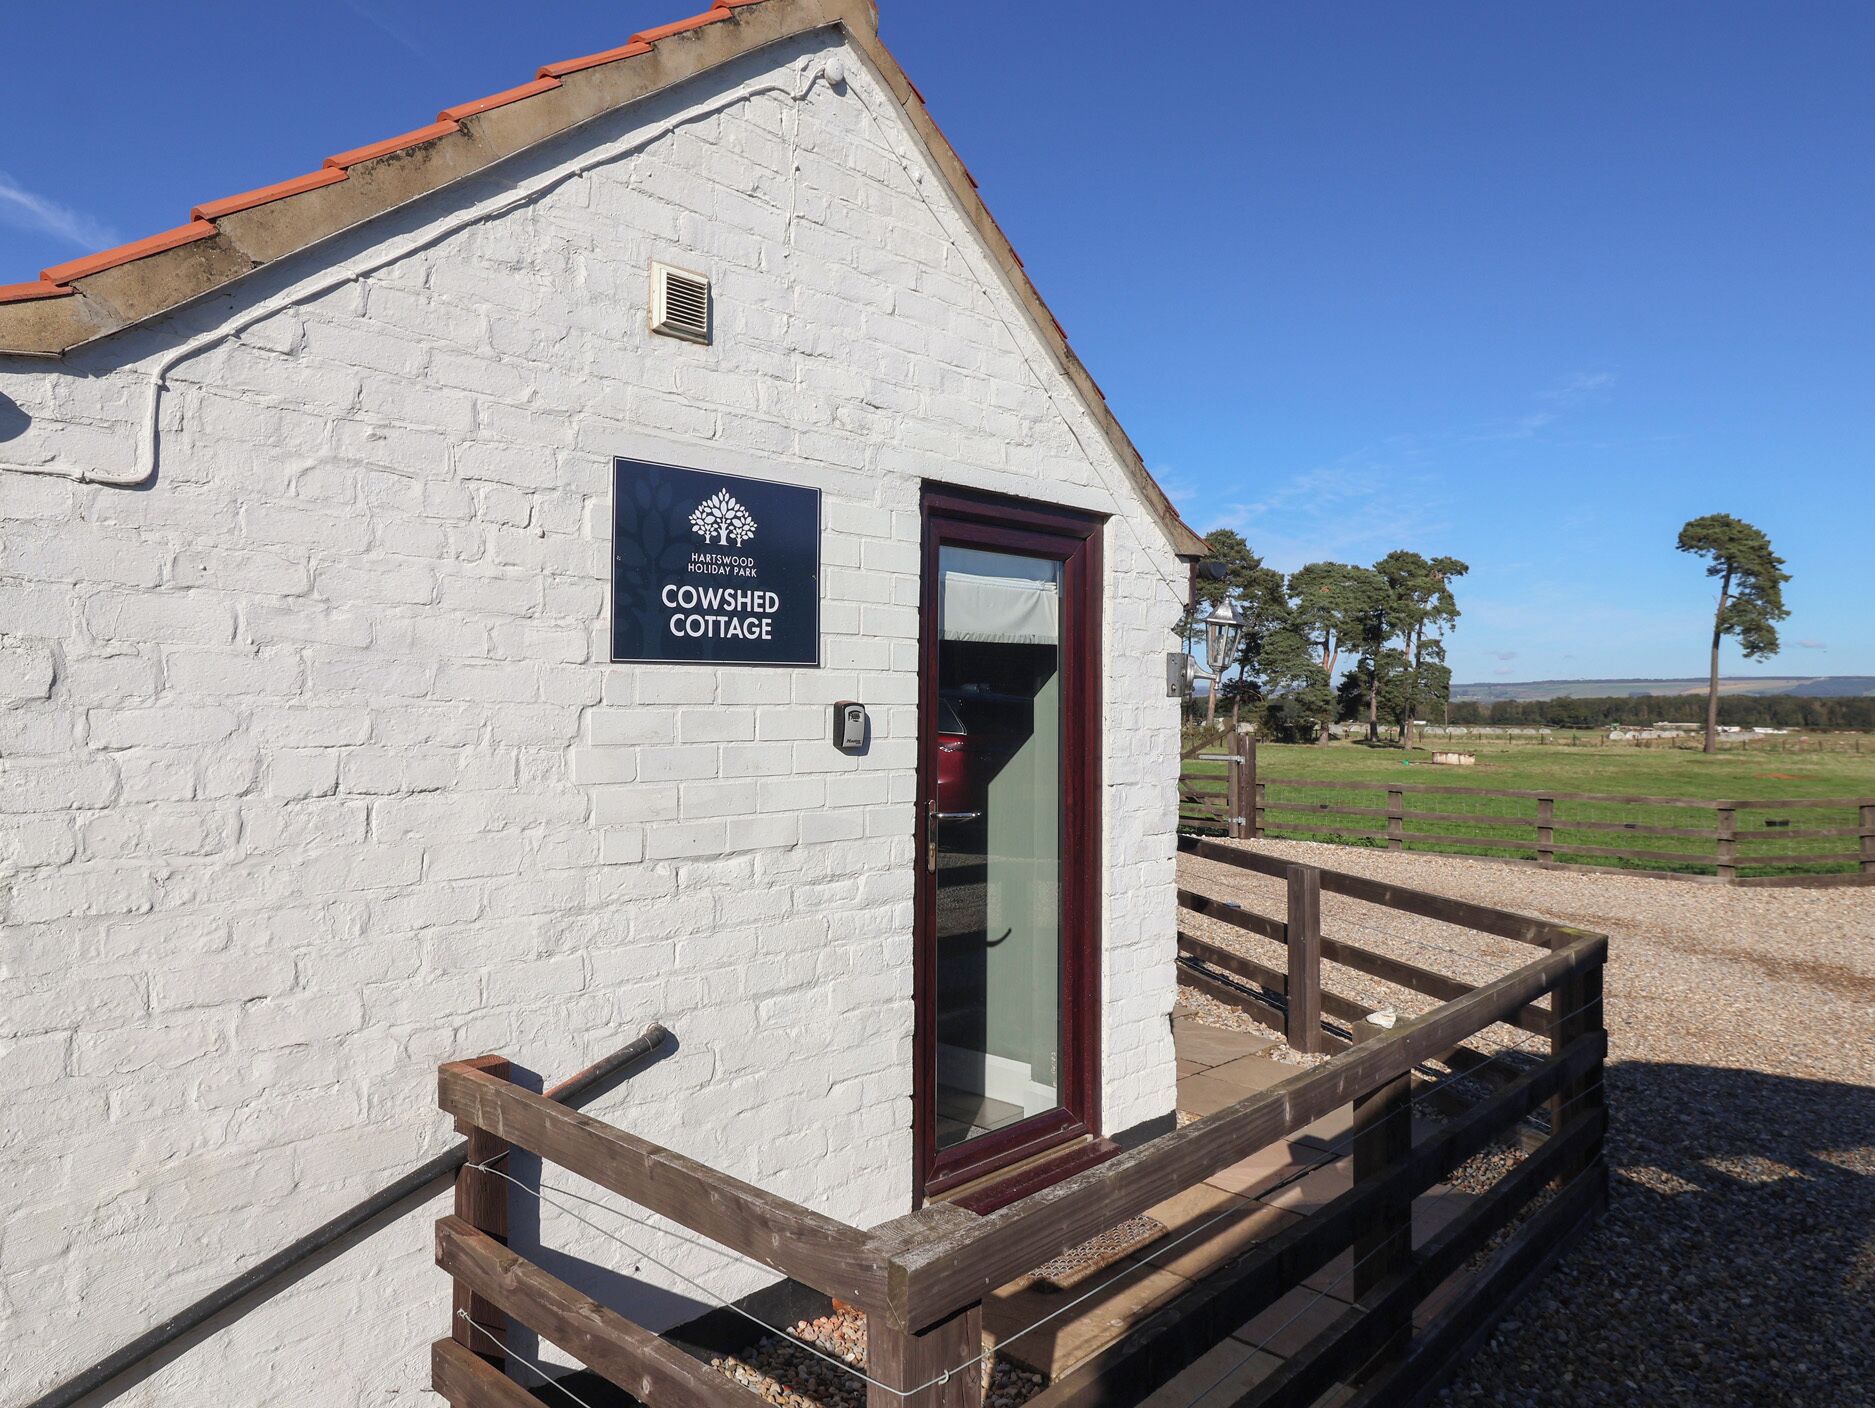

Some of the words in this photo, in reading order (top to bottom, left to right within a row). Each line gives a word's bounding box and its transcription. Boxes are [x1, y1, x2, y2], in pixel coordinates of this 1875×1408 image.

[688, 562, 731, 575] HOLIDAY
[733, 566, 757, 578] PARK
[691, 552, 754, 567] HARTSWOOD
[661, 584, 780, 613] COWSHED
[669, 613, 772, 640] COTTAGE
